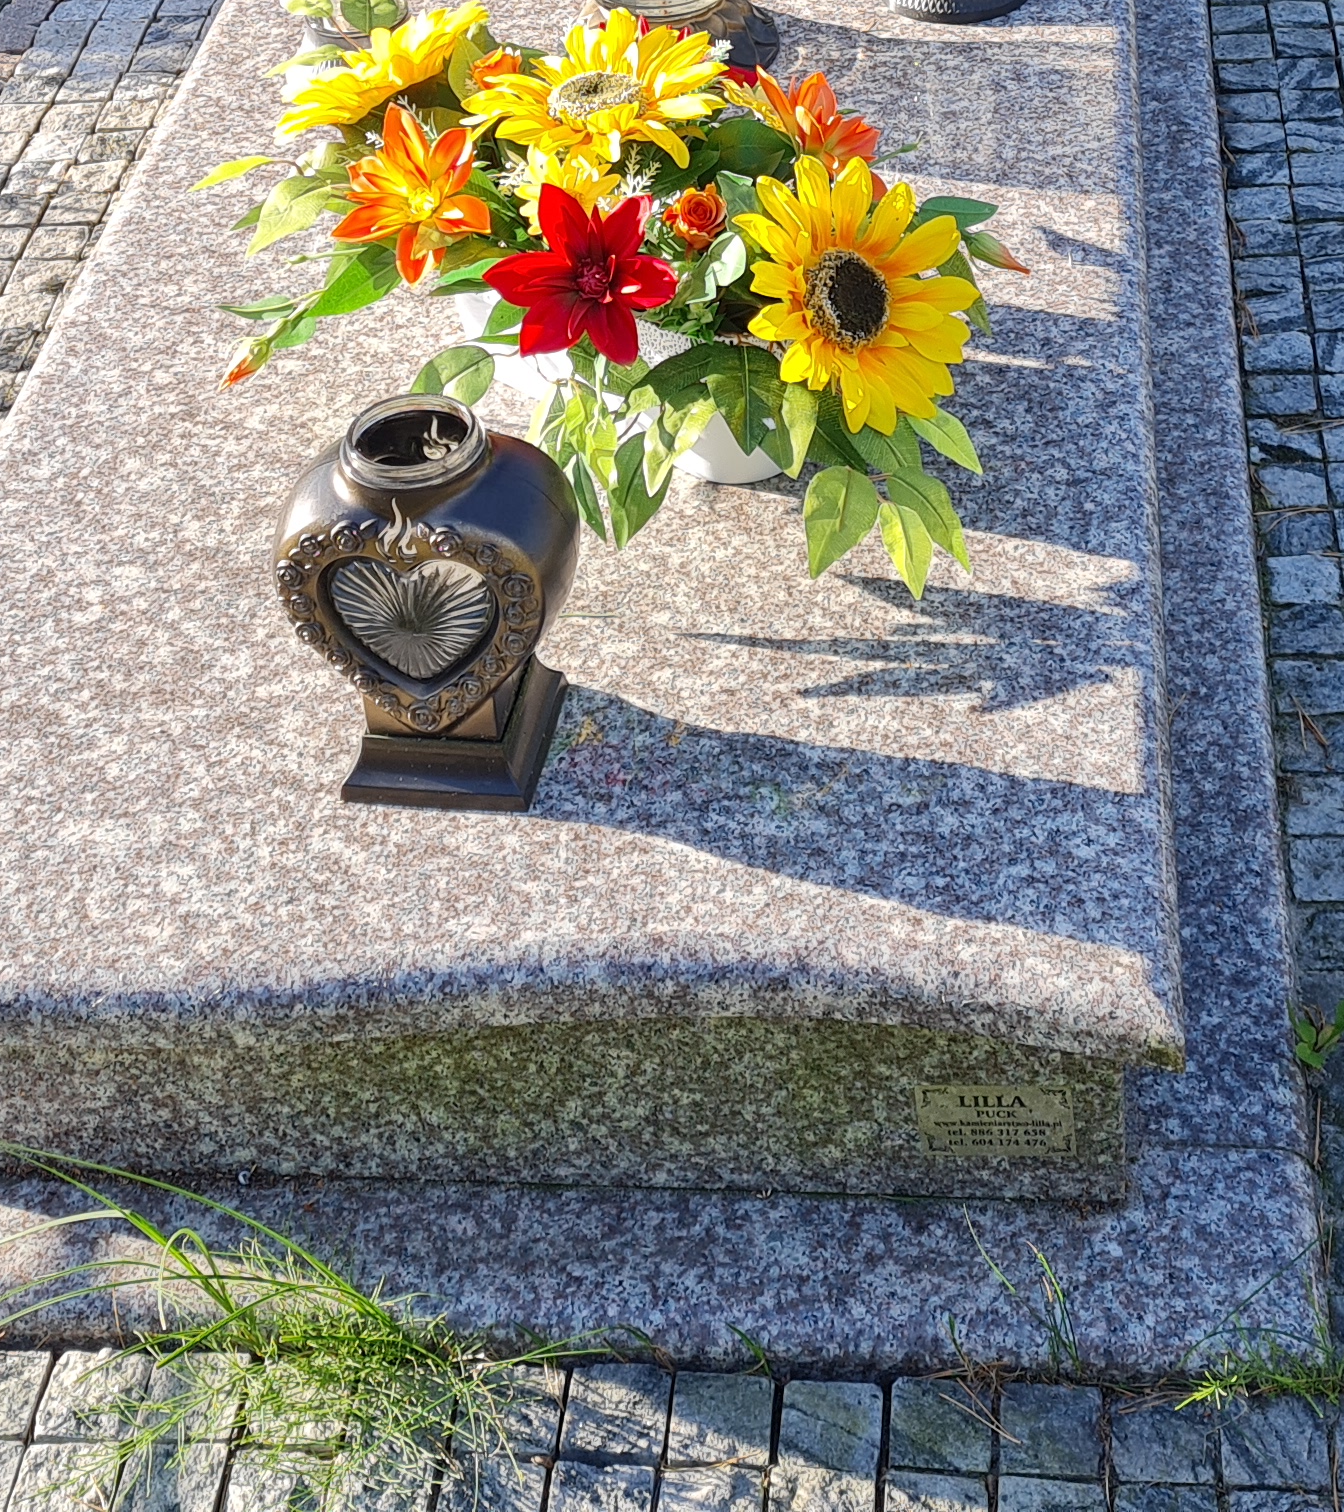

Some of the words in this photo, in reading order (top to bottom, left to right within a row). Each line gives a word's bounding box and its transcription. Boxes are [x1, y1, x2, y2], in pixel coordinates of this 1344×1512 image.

[957, 1095, 1027, 1108] LILLA
[976, 1109, 1017, 1119] PUCK
[947, 1128, 967, 1136] tel.
